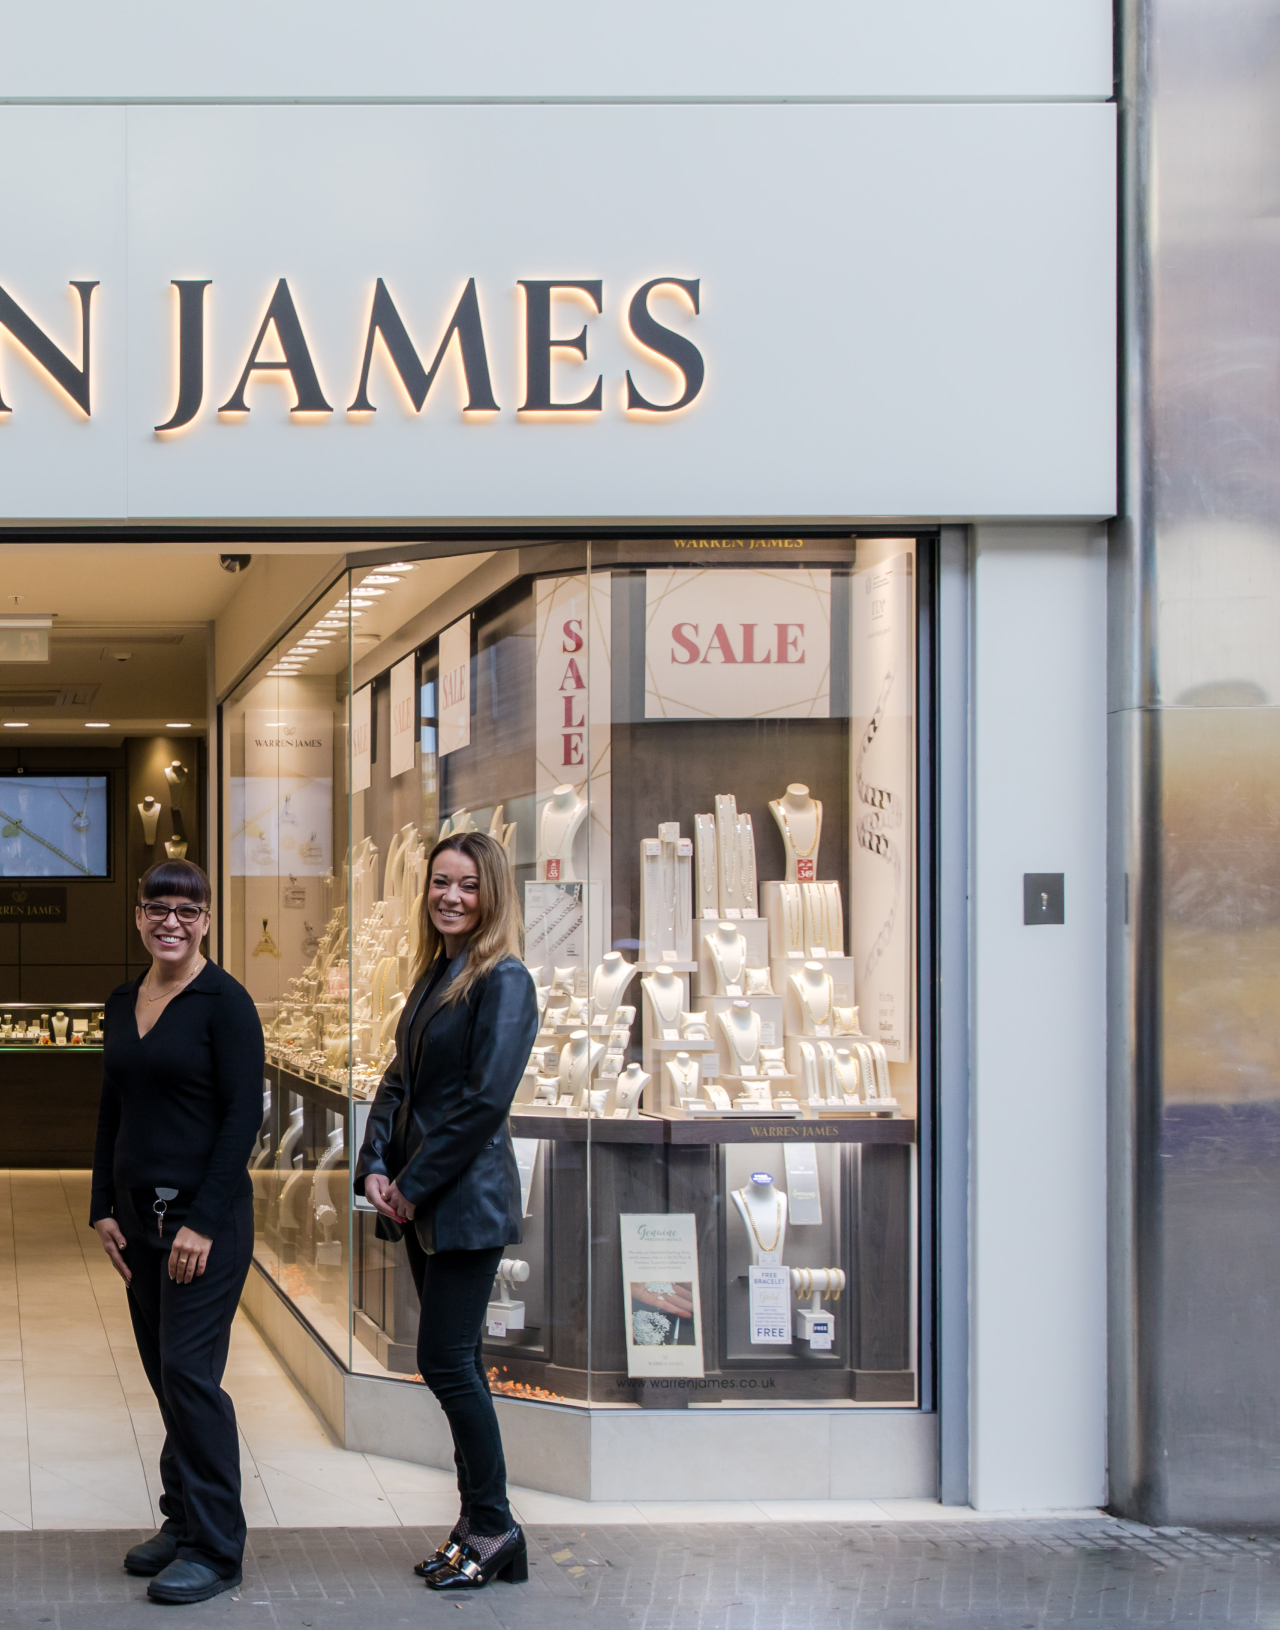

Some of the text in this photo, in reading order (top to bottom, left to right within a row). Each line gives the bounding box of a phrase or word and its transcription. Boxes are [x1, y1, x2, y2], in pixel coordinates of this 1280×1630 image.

[154, 277, 705, 432] JAMES
[671, 622, 805, 665] SALE
[443, 664, 465, 710] SALE
[558, 619, 586, 766] SALE
[393, 697, 412, 737] SALE
[255, 739, 322, 748] WARREN JAMES
[353, 723, 368, 758] SALE
[27, 905, 61, 916] JAMES
[750, 1126, 839, 1137] WARREN JAMES
[636, 1224, 677, 1241] Genuine
[756, 1327, 785, 1337] FREE
[616, 1377, 776, 1390] www.warrenjames.co.uk
